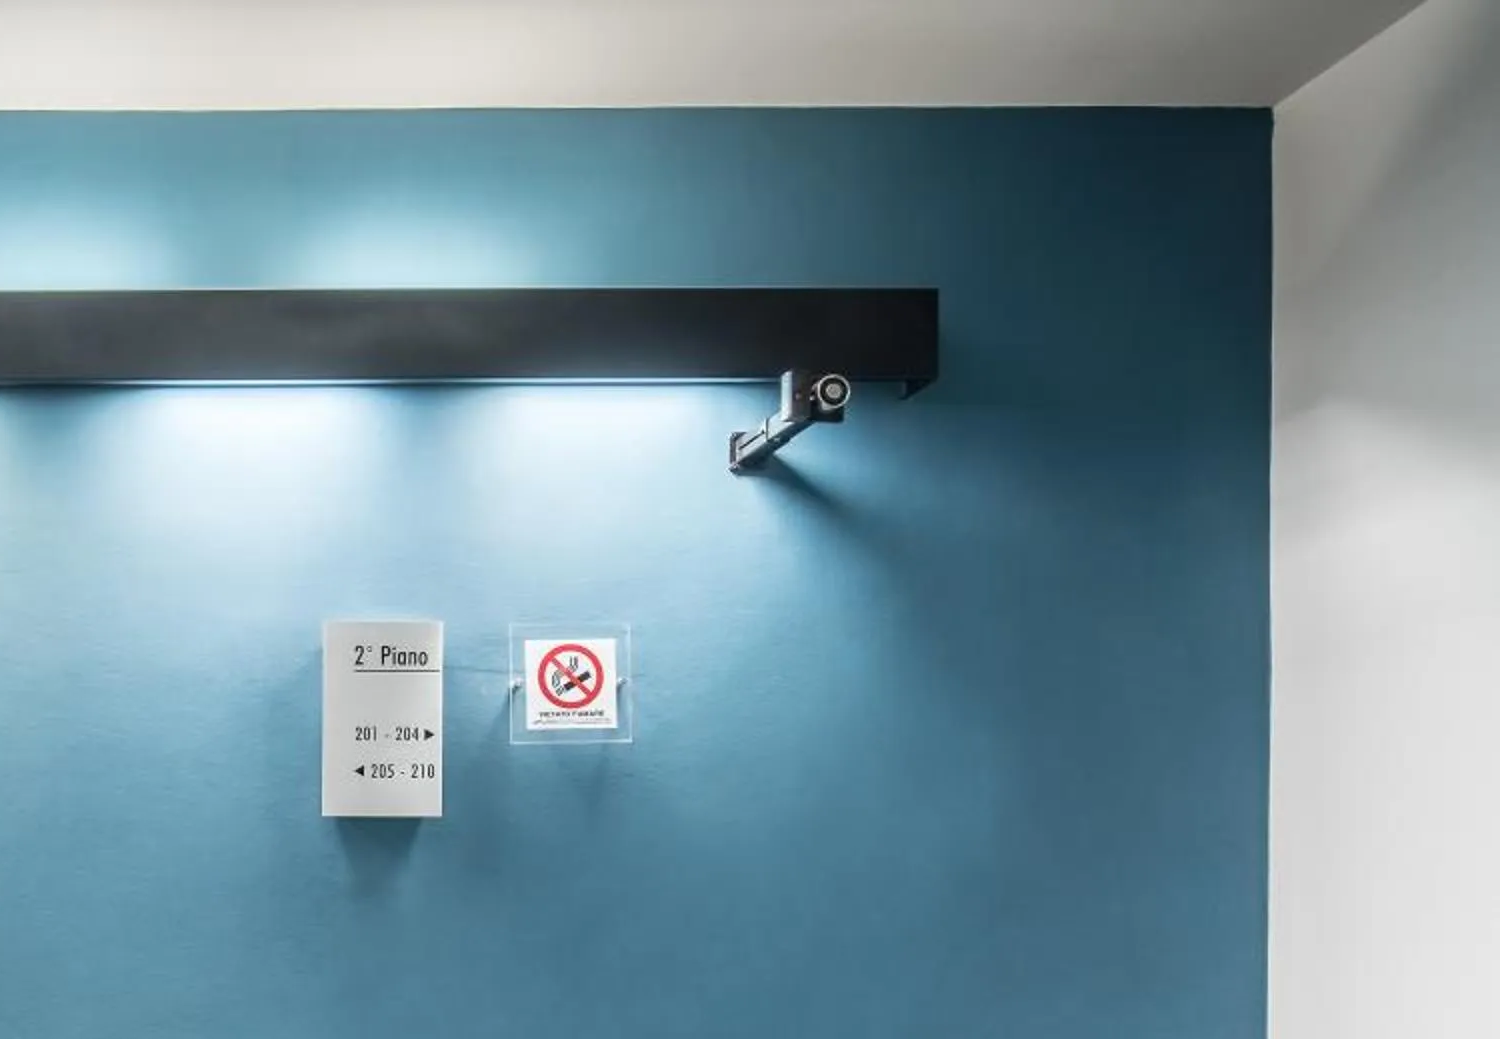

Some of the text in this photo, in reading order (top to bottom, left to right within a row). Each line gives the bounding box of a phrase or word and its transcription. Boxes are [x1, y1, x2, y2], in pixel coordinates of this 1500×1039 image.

[355, 645, 429, 667] 2° Piano
[355, 726, 377, 741] 201
[395, 726, 419, 741] 204
[371, 763, 395, 779] 205
[411, 763, 435, 779] 210
